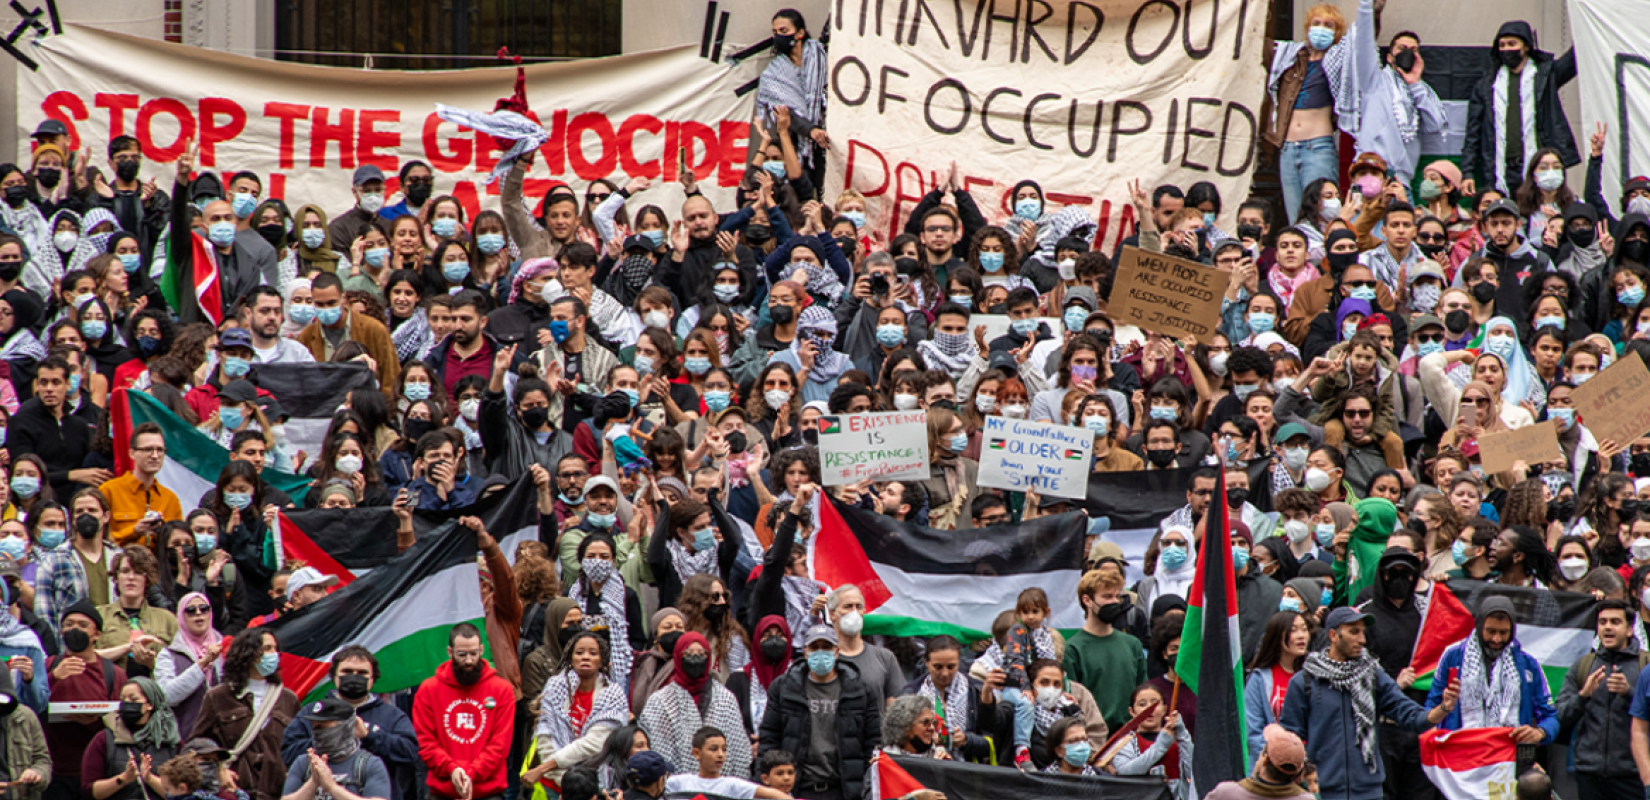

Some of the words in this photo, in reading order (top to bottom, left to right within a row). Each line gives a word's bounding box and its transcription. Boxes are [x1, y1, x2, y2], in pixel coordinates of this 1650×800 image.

[832, 55, 909, 114] OF
[924, 78, 1257, 176] OCCUPIED
[31, 91, 246, 169] STOP
[263, 102, 400, 172] THE
[1134, 272, 1158, 286] ARE
[1160, 278, 1213, 302] OCCUPIED
[1129, 306, 1144, 319] IS
[848, 412, 927, 432] EXISTENCE
[986, 417, 1006, 431] MY
[867, 431, 885, 445] IS
[1008, 439, 1062, 460] OLDER
